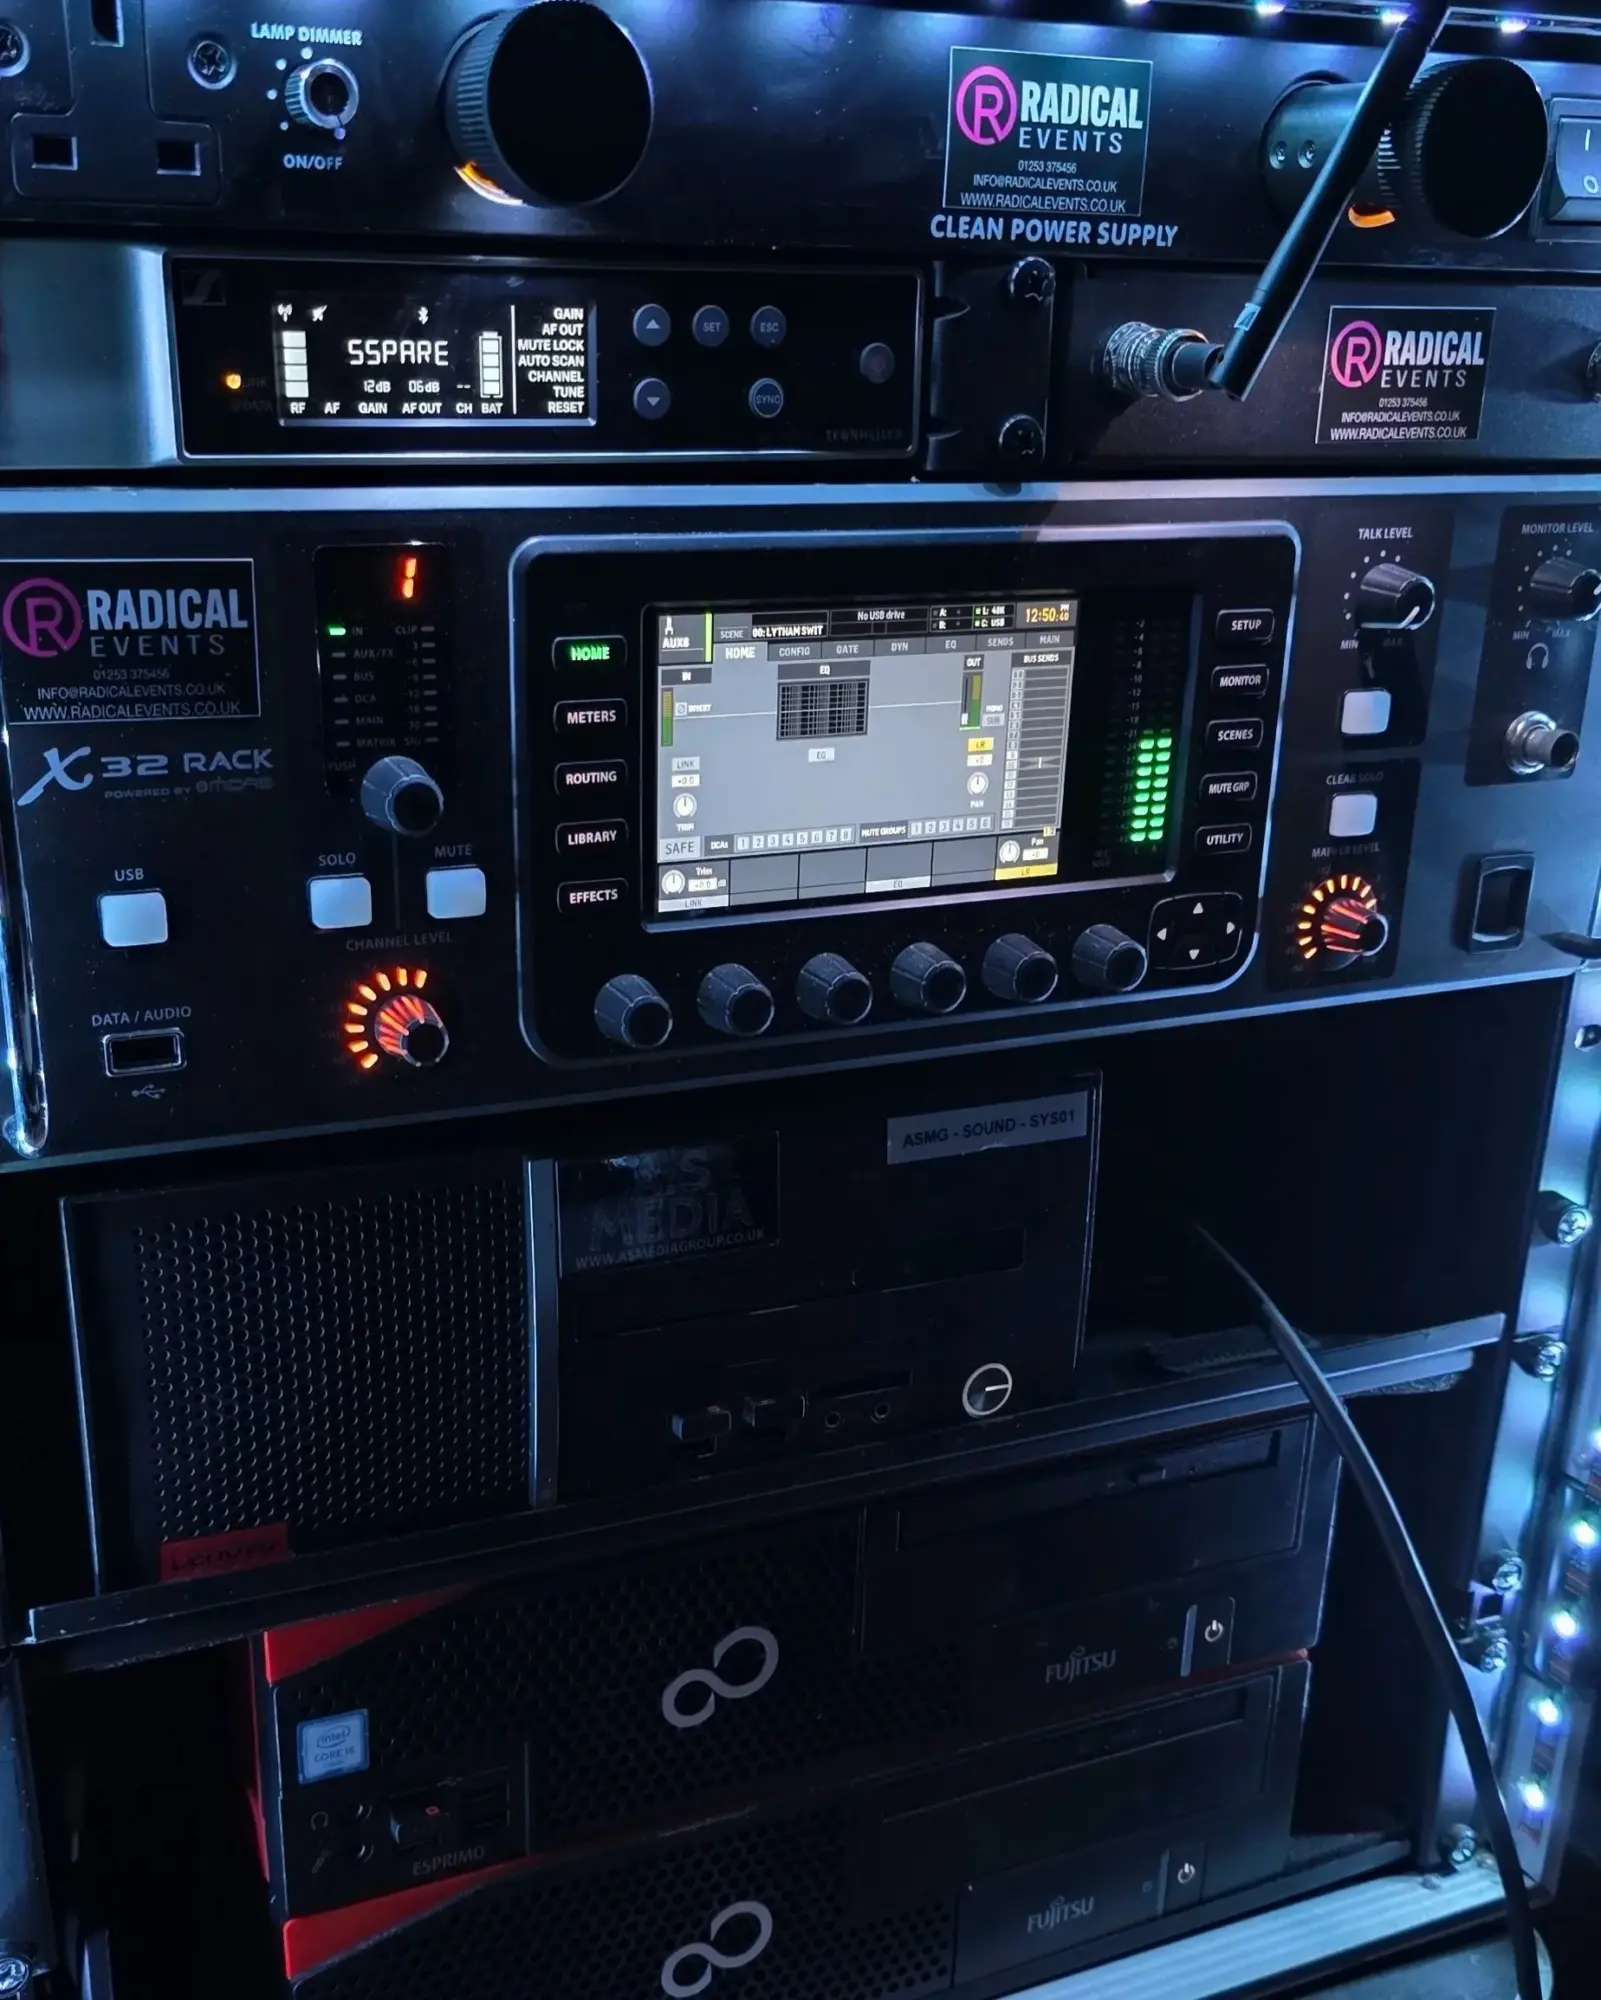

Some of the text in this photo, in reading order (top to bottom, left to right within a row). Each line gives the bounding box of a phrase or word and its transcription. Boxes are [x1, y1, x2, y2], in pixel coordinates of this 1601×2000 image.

[251, 22, 363, 46] LAMP DIMMER
[1020, 81, 1143, 129] RADICAL
[1018, 127, 1123, 154] EVENTS
[283, 153, 344, 170] ON/OFF
[1018, 160, 1077, 174] 01253 375456
[973, 174, 1117, 193] INFO@RADICALEVENTS.CO.UK
[960, 192, 1127, 213] WWW.RADICALEVENTS.CO.UK
[930, 214, 1179, 247] CLEAN POWER SUPPLY
[553, 307, 584, 321] GAIN
[541, 323, 584, 337] AF OUT
[703, 322, 721, 332] SET
[760, 322, 779, 333] ESC
[518, 339, 585, 352] MUTE LOCK
[1383, 330, 1484, 366] RADICAL
[518, 354, 585, 367] AUTO SCAN
[528, 369, 584, 383] CHANNEL
[1380, 370, 1467, 389] EVENTS
[363, 379, 391, 394] 12dB
[553, 386, 584, 398] TUNE
[756, 395, 781, 405] SYNC
[1379, 397, 1428, 408] 01253 375456
[290, 402, 503, 415] RF AF GAIN AF OUT CH BAT
[547, 401, 584, 414] RESET
[1341, 411, 1460, 423] INFO@RADICALEVENTS.CO.UK
[1330, 427, 1467, 441] WWW.RADICALEVENTS.CO.UK
[1358, 527, 1414, 541] TALK LEVEL
[1521, 522, 1594, 535] MONITOR LEVEL
[86, 588, 248, 631] RADICAL
[857, 609, 905, 621] No USB drive
[991, 618, 1005, 627] USB
[1231, 619, 1262, 631] SETUP
[352, 626, 364, 636] IN
[720, 630, 744, 639] SCENE
[766, 626, 800, 637] LYTHAM
[801, 625, 824, 636] SWIT
[1512, 630, 1530, 641] MIN
[90, 634, 225, 658] EVENTS
[725, 635, 1060, 660] HOME CONFIG GATE DYN EQ SENDS MAIN
[1340, 639, 1359, 651] MIN
[570, 645, 610, 661] HOME
[1023, 653, 1059, 663] BUS SENDS
[966, 657, 982, 668] OUT
[93, 668, 170, 681] 01253 375456
[353, 671, 375, 682] BUS
[1219, 674, 1261, 687] MONITOR
[37, 683, 226, 701] INFO@RADICALEVENTS.CO.UK
[354, 694, 377, 704] DCA
[24, 702, 241, 721] WWW.RADICALEVENTS.CO.UK
[566, 710, 616, 724] METERS
[355, 716, 384, 726] MAIN
[1217, 728, 1253, 741] SCENES
[356, 736, 396, 749] MATRIX
[183, 749, 274, 773] RACK
[816, 751, 826, 759] EQ
[676, 760, 695, 769] LINK
[566, 771, 617, 786] ROUTING
[104, 786, 192, 799] POWERED BY
[1208, 781, 1250, 794] MUTE GRP
[970, 800, 984, 808] PAN
[568, 830, 617, 846] LIBRARY
[861, 825, 907, 838] MUTE GROUPS
[1206, 832, 1244, 845] UTILITY
[665, 841, 695, 855] SAFE
[1031, 838, 1044, 846] Pan
[434, 844, 472, 858] MUTE
[318, 852, 356, 867] SOLO
[114, 868, 144, 882] USB
[893, 880, 903, 888] EQ
[569, 889, 618, 905] EFFECTS
[684, 899, 702, 908] LINK
[345, 931, 453, 952] CHANNEL LEVEL
[91, 1012, 130, 1027] DATA
[143, 1005, 192, 1021] AUDIO
[903, 1128, 948, 1148] ASMG
[963, 1118, 1016, 1139] SOUND
[1029, 1109, 1075, 1128] SYS01
[589, 1187, 754, 1252] MEDIA
[575, 1226, 765, 1270] WWW.ASMEDIAGROUP.CO.UK
[1045, 1647, 1117, 1683] FUJITSU
[314, 1748, 344, 1763] CORE
[412, 1845, 486, 1877] ESPRIMO
[1027, 1897, 1094, 1933] FUJITSU
